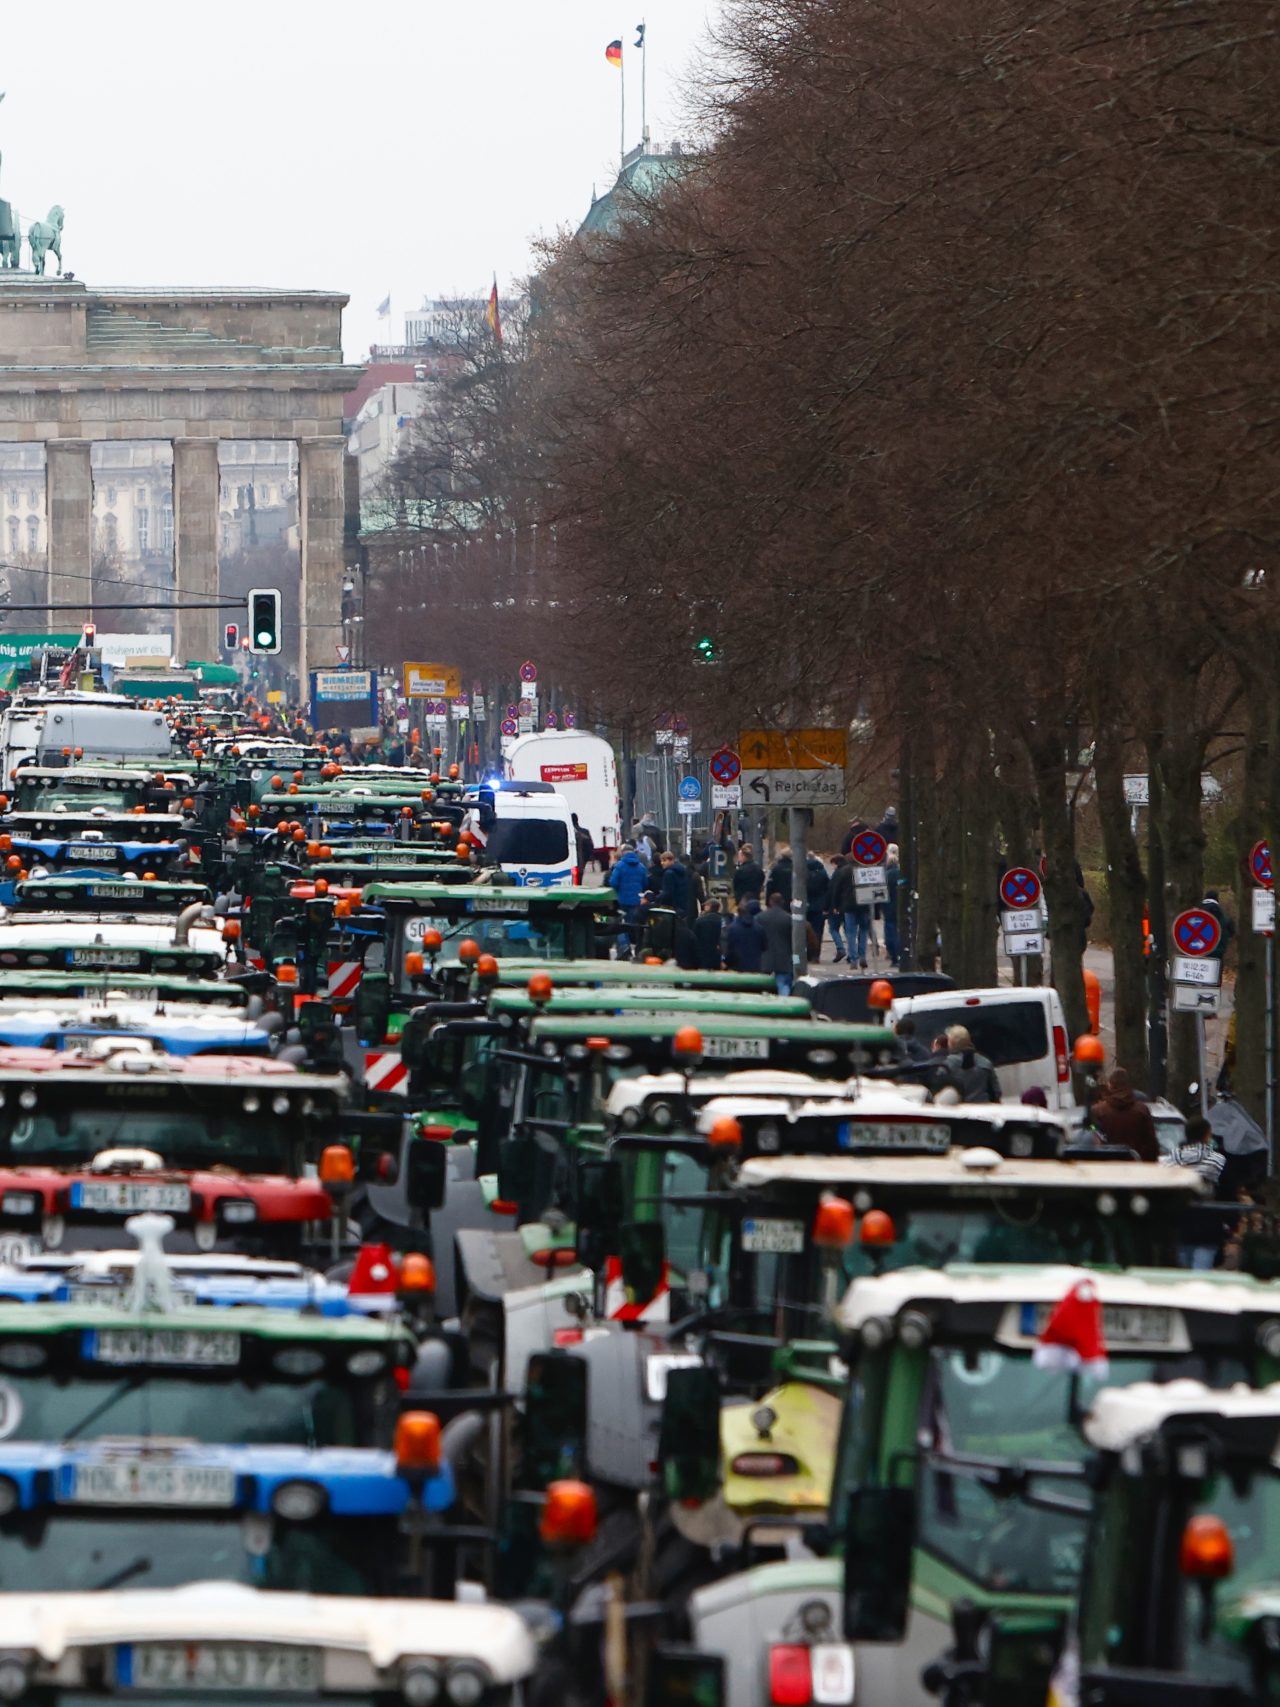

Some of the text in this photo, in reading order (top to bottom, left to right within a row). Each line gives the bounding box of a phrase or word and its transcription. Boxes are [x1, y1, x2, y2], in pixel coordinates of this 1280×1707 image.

[775, 780, 837, 794] Reichstag
[715, 850, 727, 875] P
[409, 922, 426, 938] 50
